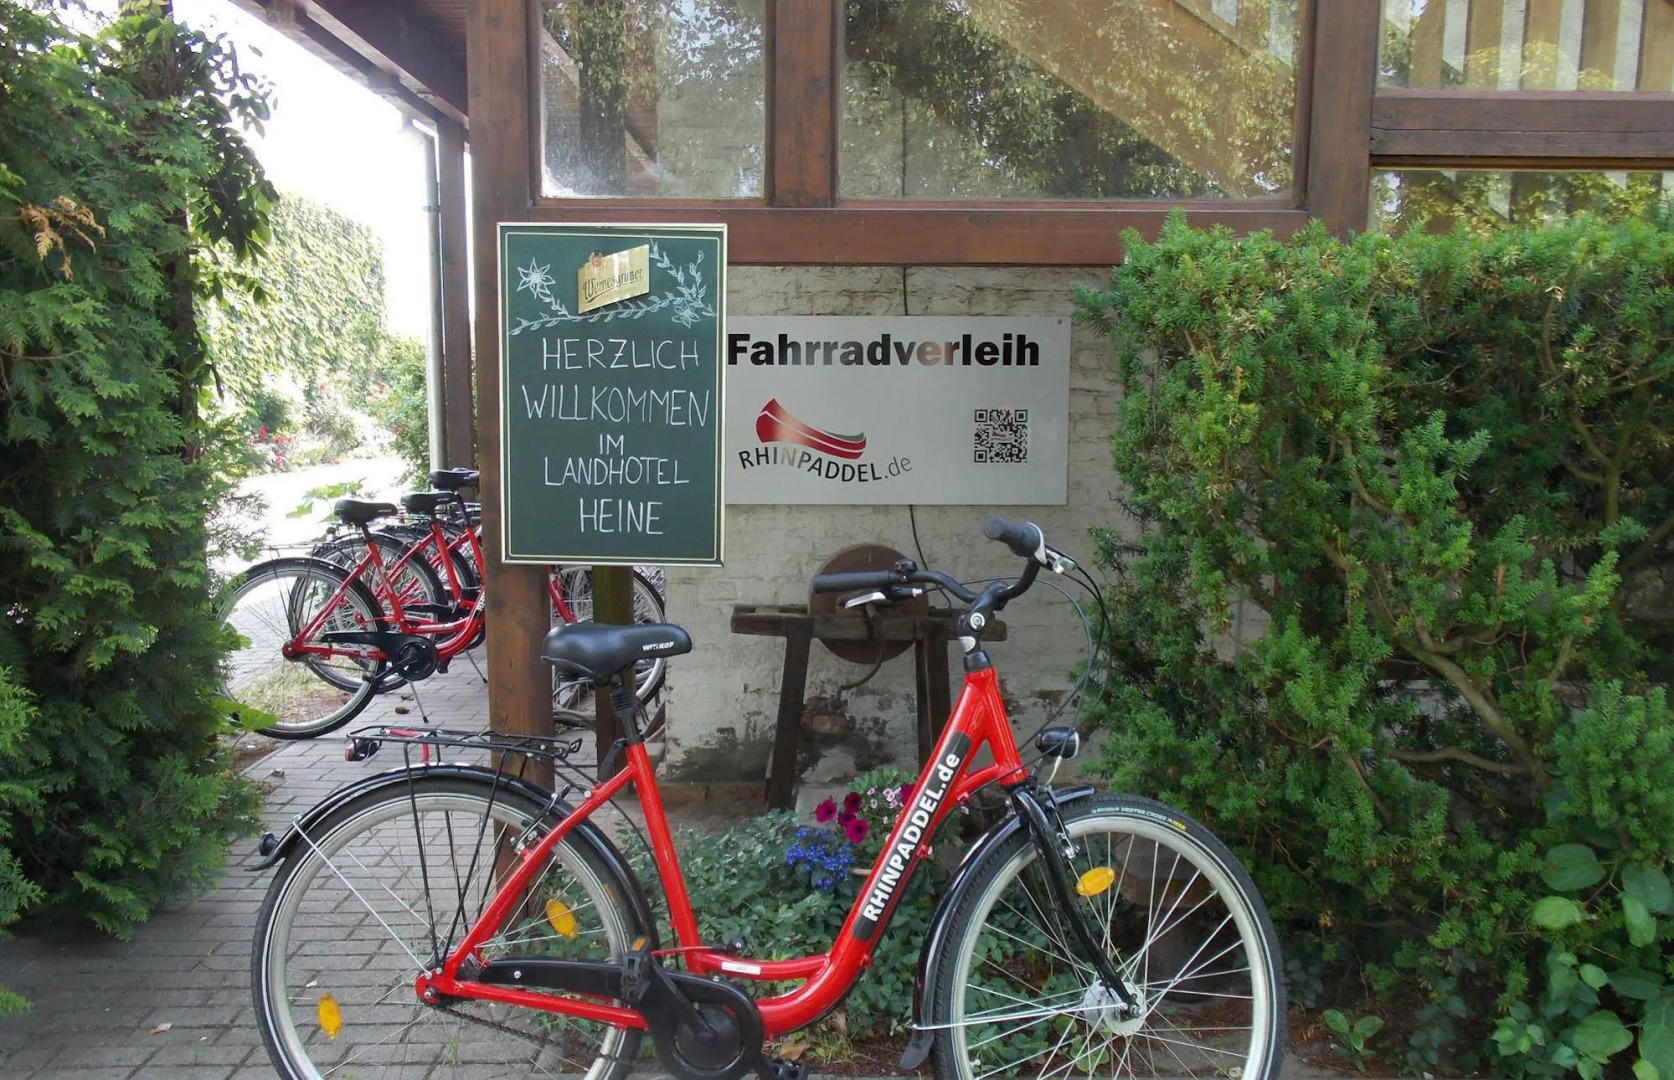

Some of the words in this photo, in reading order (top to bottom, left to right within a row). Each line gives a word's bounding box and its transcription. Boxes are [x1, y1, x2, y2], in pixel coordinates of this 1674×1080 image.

[542, 338, 699, 370] HERZLICH
[728, 333, 1040, 367] Fahrradverleih
[521, 384, 710, 427] WILLKOMMEN
[599, 434, 625, 456] IM
[544, 457, 690, 486] LANDHOTEL
[738, 445, 913, 483] RHINPADDEL.de
[580, 498, 664, 535] HEINE
[862, 753, 960, 922] RHINPADDEL.de
